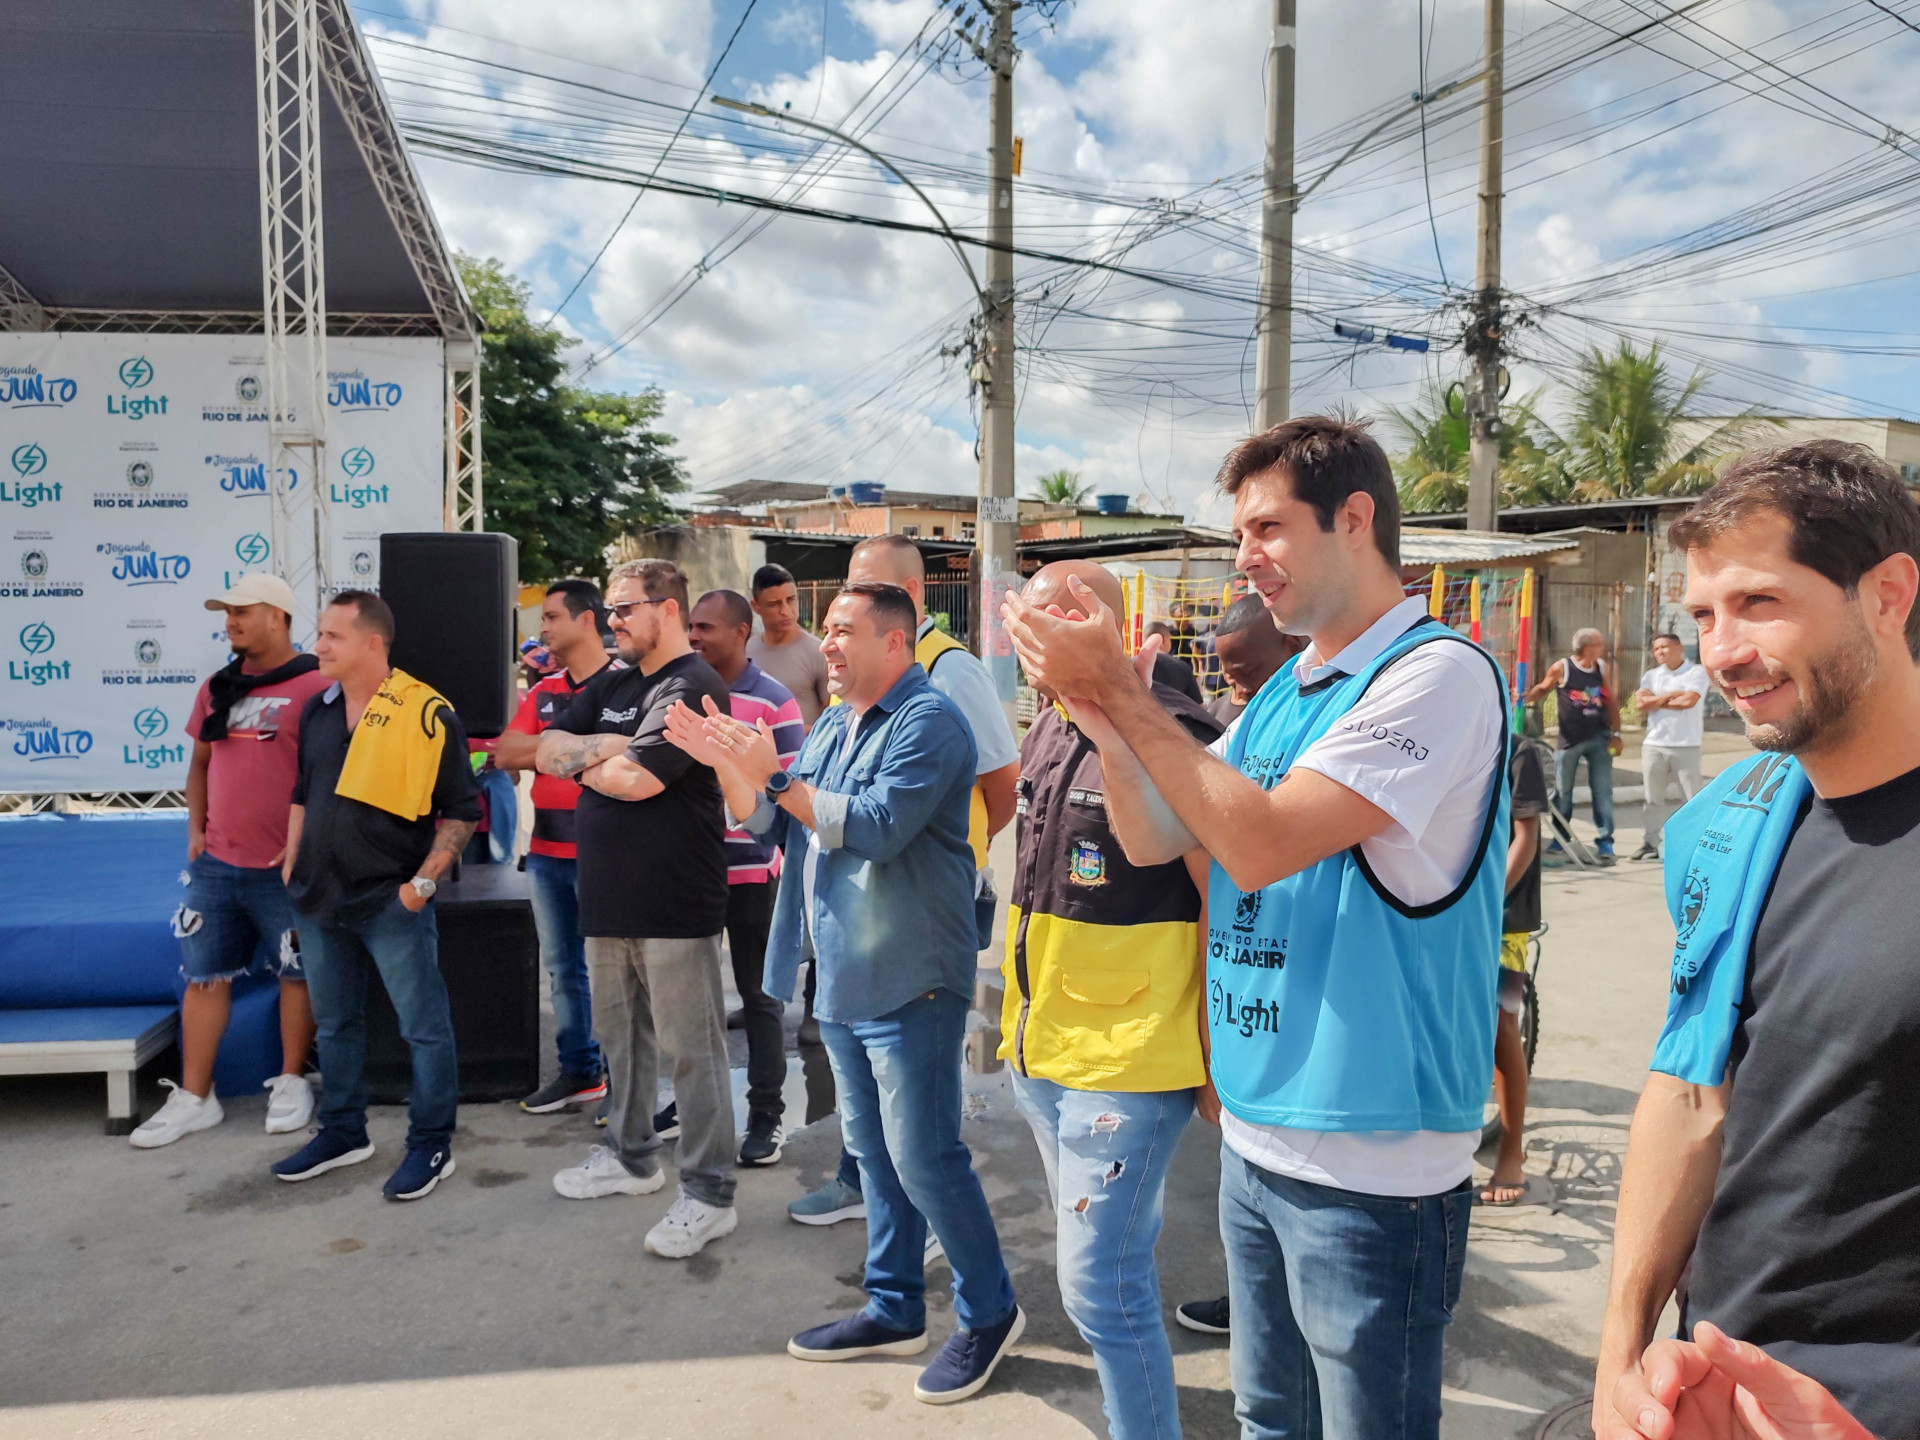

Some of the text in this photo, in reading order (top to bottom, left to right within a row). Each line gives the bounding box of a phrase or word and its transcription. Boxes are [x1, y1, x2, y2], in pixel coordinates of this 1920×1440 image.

[0, 363, 37, 378] ogando
[0, 373, 78, 403] JUNTO
[328, 378, 402, 406] JUNTO
[107, 395, 169, 420] Light
[202, 412, 224, 421] RIO
[227, 412, 242, 421] DE
[0, 482, 62, 508] Light
[94, 499, 188, 508] RIO DE JANEIRO
[331, 484, 389, 508] Light
[112, 551, 190, 580] JUNTO
[13, 588, 29, 597] DE
[32, 588, 84, 597] JANEIRO
[9, 660, 71, 685] Light
[102, 675, 196, 684] RIO DE JANEIRO
[14, 727, 93, 755] JUNTO
[123, 744, 184, 769] Light
[1235, 935, 1252, 946] DO
